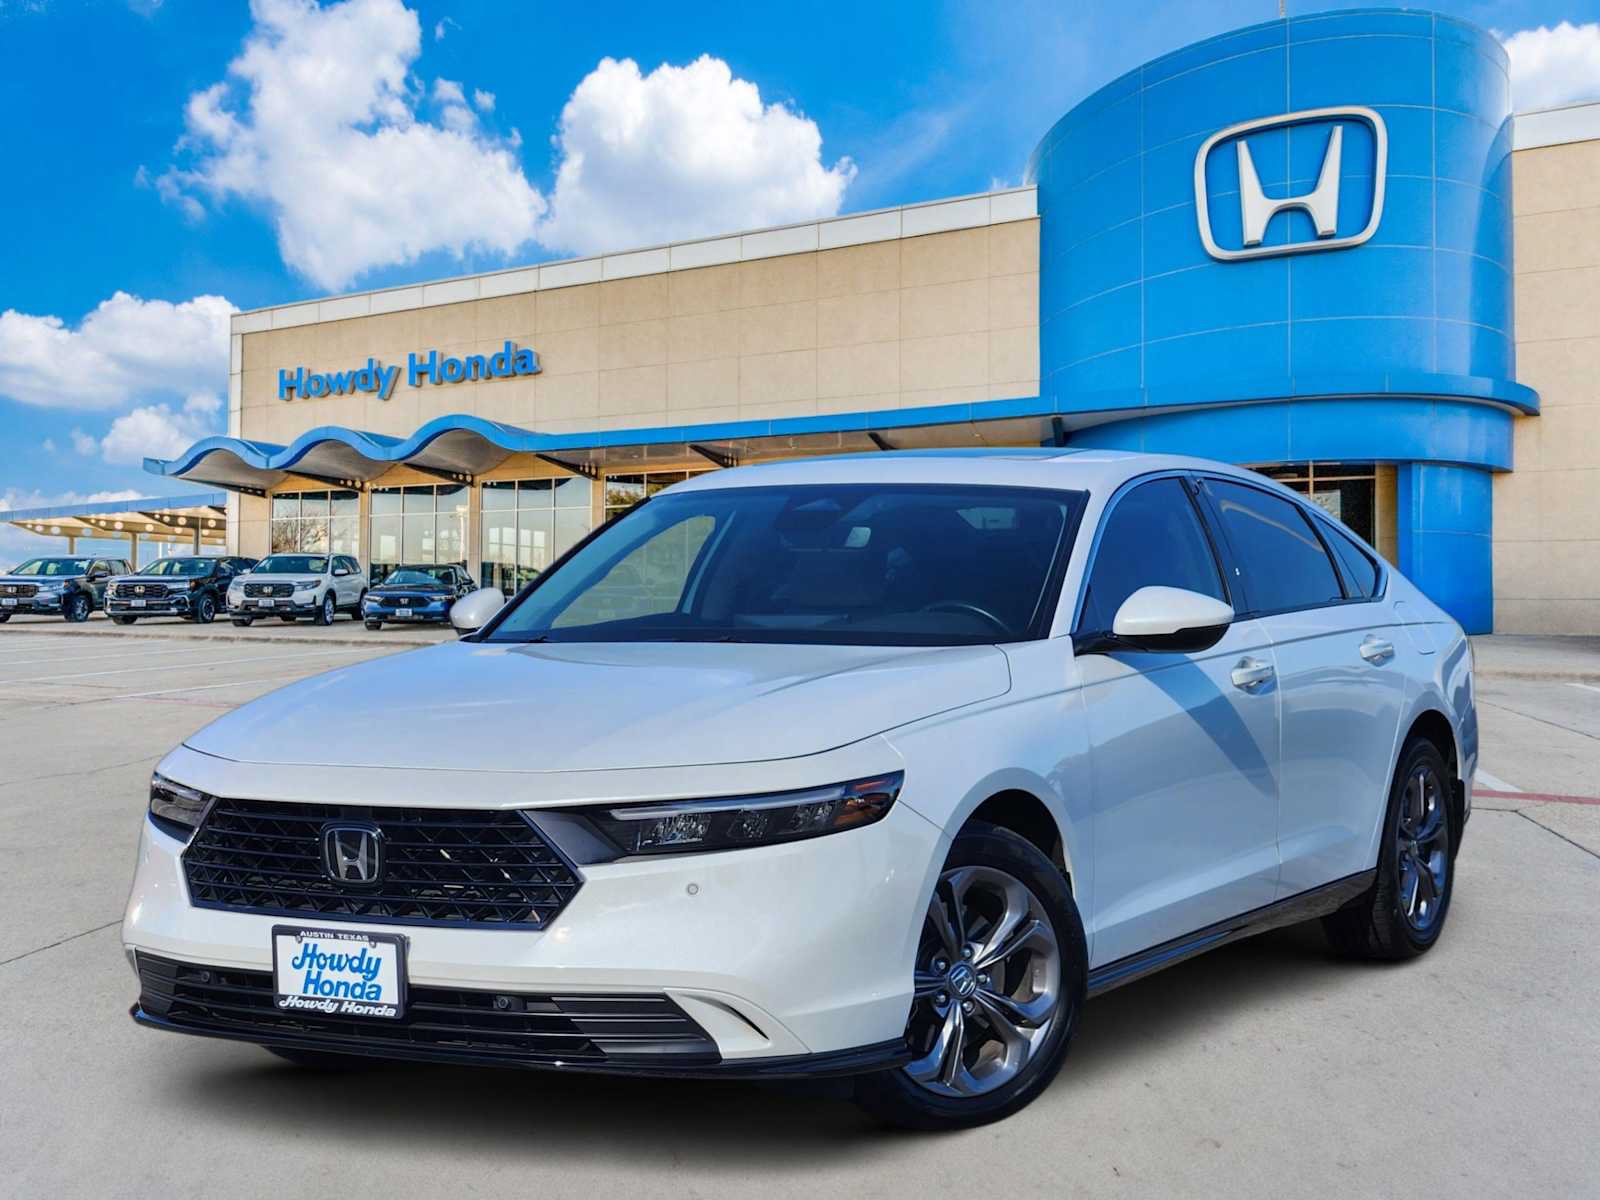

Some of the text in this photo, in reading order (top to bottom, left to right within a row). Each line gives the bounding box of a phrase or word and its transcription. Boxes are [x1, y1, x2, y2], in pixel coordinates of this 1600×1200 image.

[278, 340, 542, 401] Howdy Honda
[300, 930, 369, 941] AUSTIN TEXAS
[291, 943, 382, 981] Howdy
[302, 969, 382, 1001] Honda
[279, 995, 397, 1017] Howdy Honda
